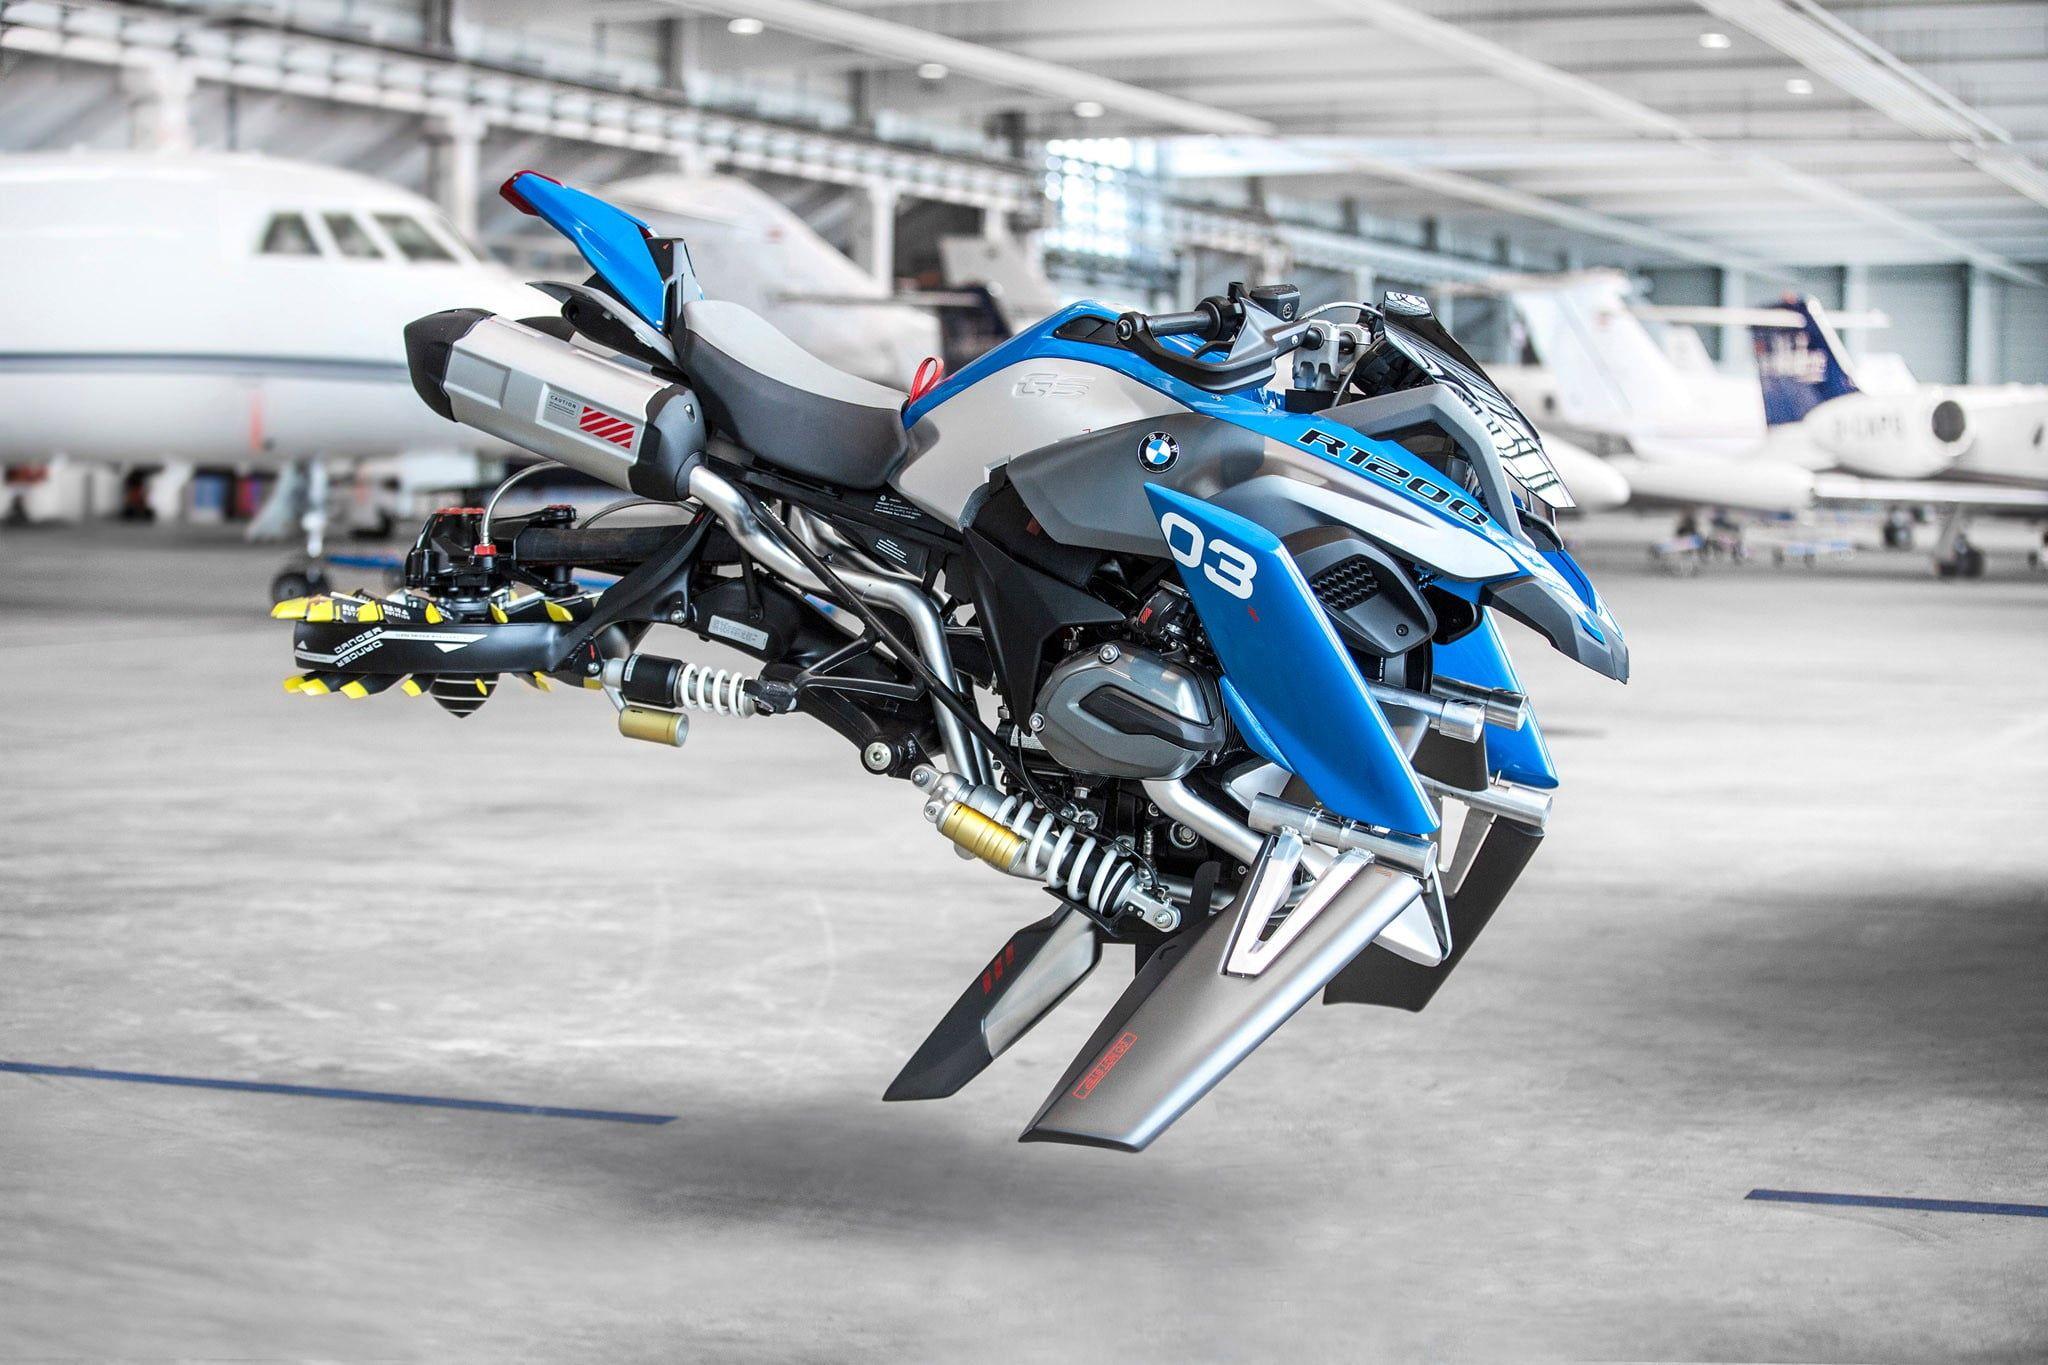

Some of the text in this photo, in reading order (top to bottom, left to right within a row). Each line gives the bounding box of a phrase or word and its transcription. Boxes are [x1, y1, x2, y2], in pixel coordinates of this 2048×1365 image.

[1012, 371, 1097, 396] GS
[550, 395, 576, 409] CAUTION
[1160, 511, 1258, 600] 03
[334, 627, 383, 654] DANGER
[335, 640, 384, 668] DANGER
